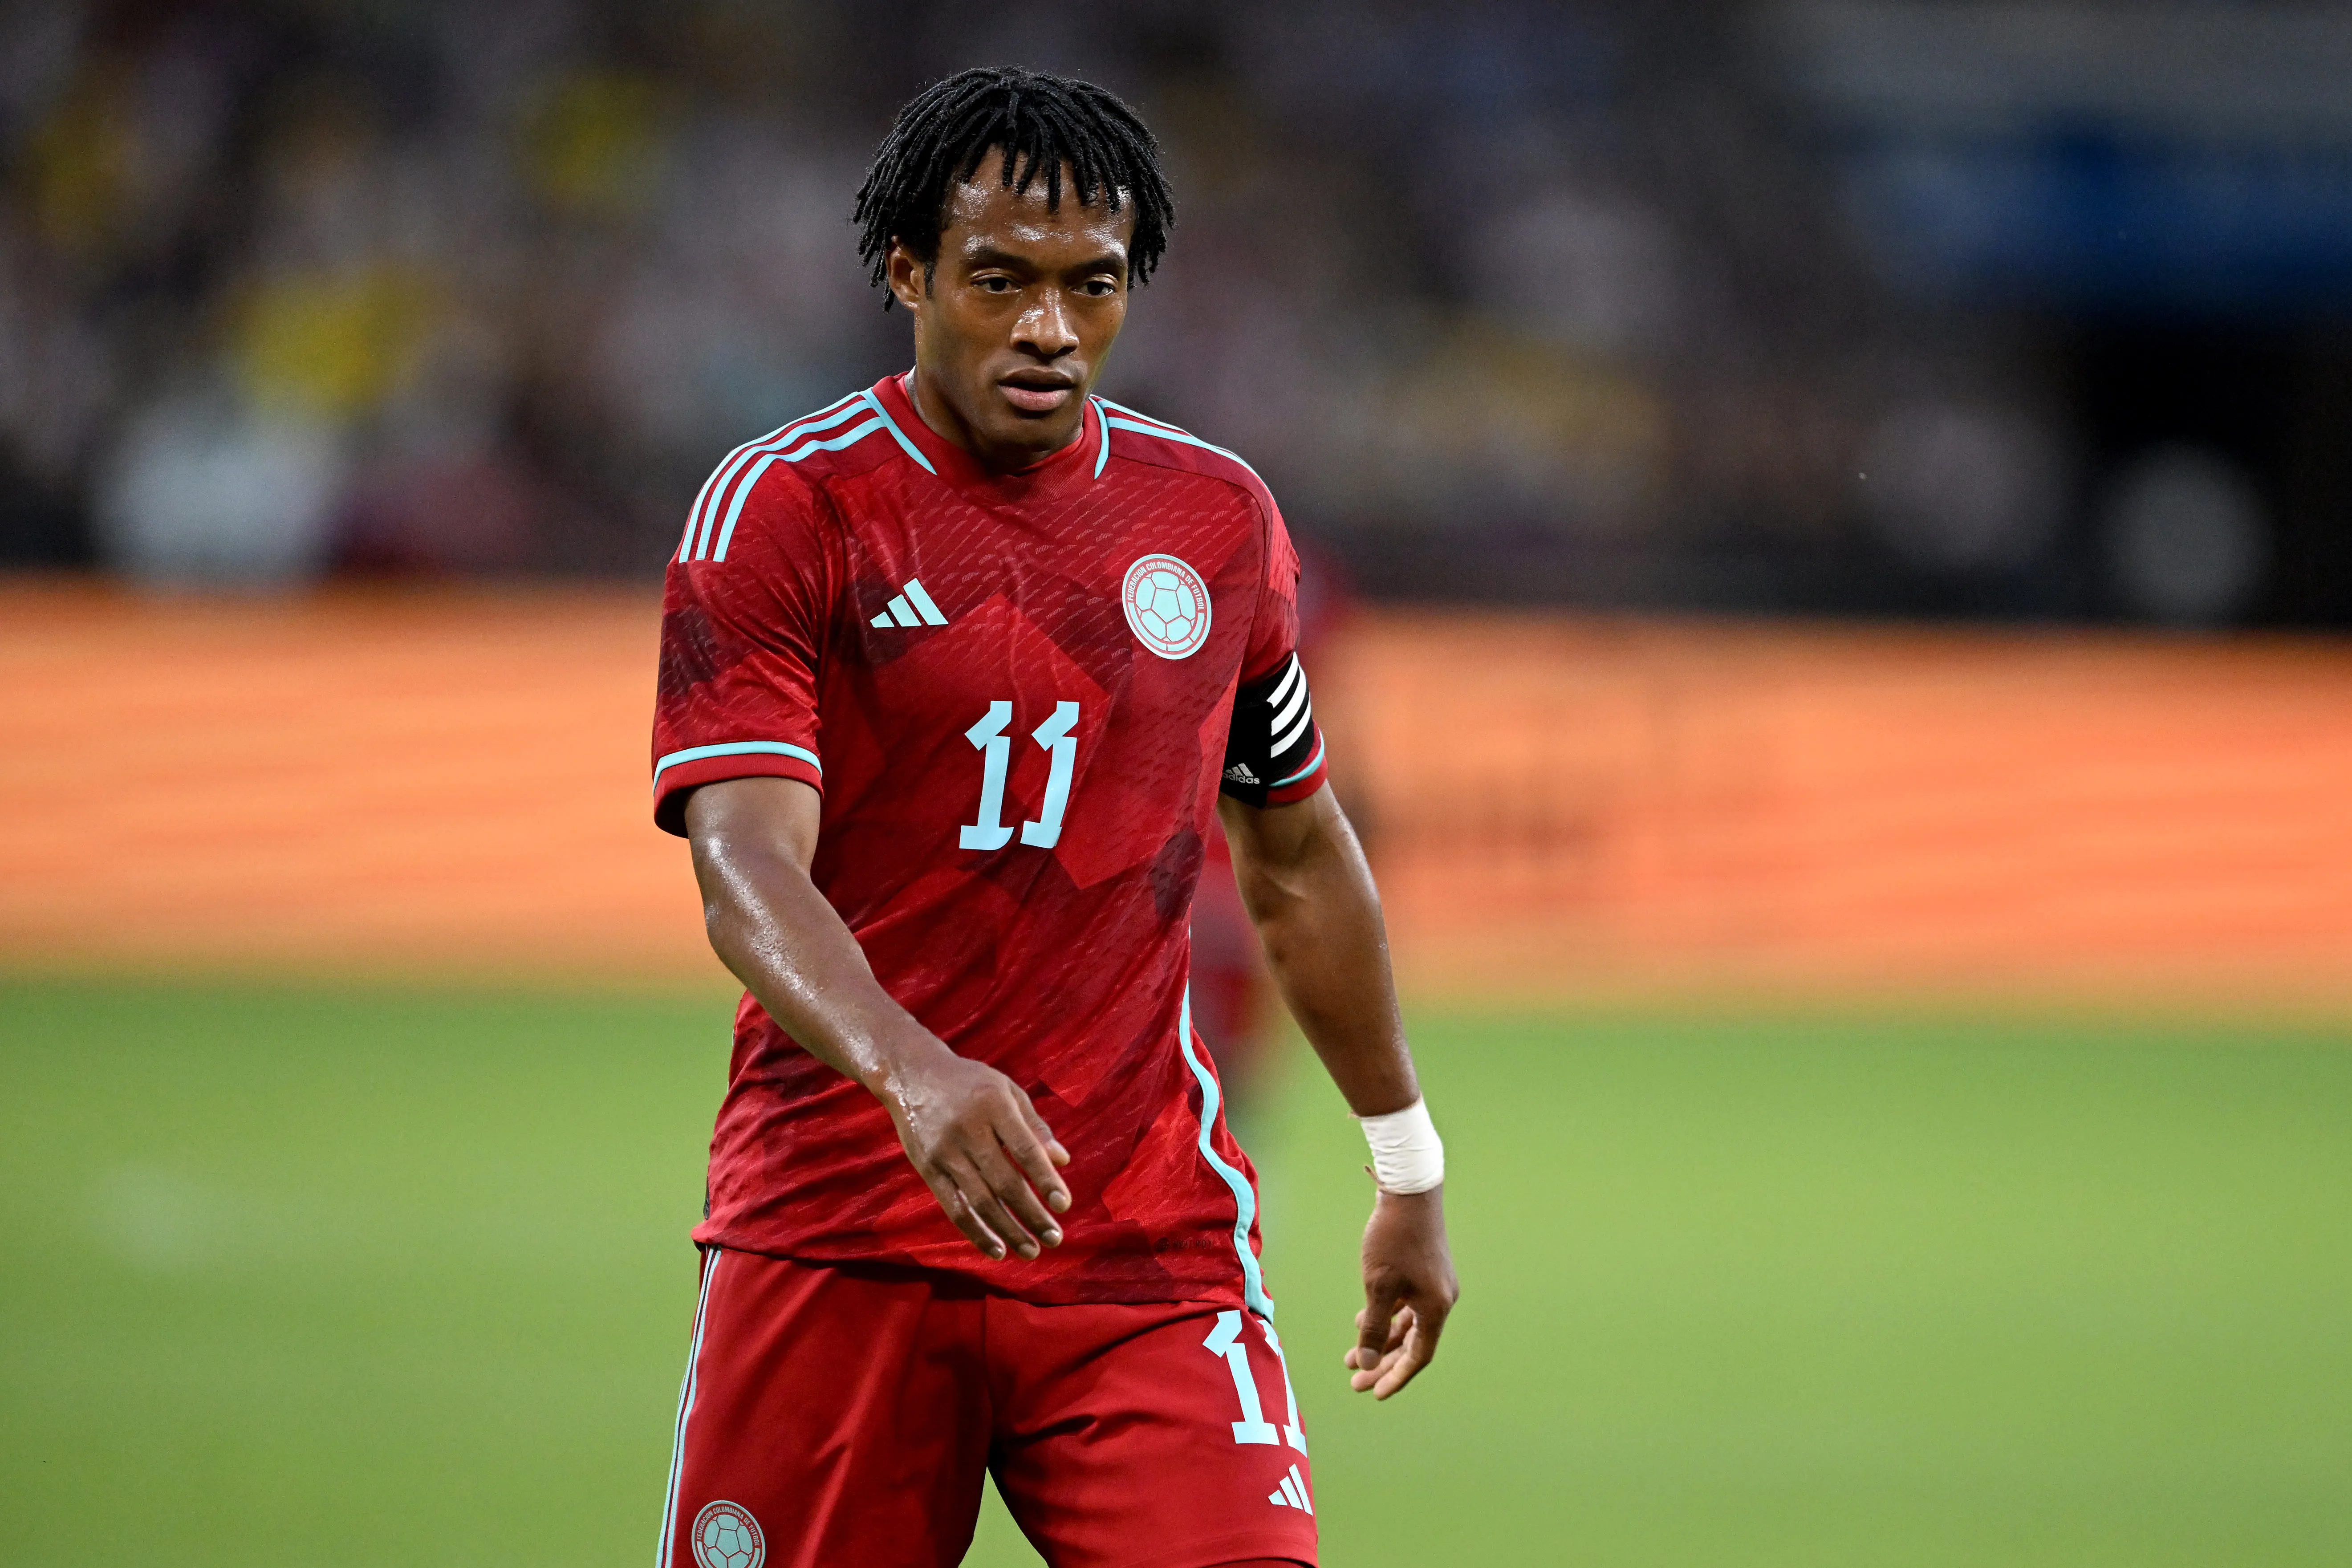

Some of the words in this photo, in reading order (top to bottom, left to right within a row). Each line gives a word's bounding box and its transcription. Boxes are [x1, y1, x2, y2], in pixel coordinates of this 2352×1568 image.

[1127, 566, 1148, 601] FEDERACION
[1146, 561, 1186, 577] COLOMBIANA
[1185, 575, 1194, 585] DE
[1191, 584, 1204, 610] FUTBOL
[959, 700, 1080, 850] 11
[1223, 772, 1260, 784] adidas
[1202, 1310, 1307, 1458] 11
[697, 1510, 713, 1540] FEDERACION
[713, 1506, 743, 1519] COLOMBIANA
[743, 1517, 751, 1526] DE
[749, 1525, 760, 1546] FUTBOL
